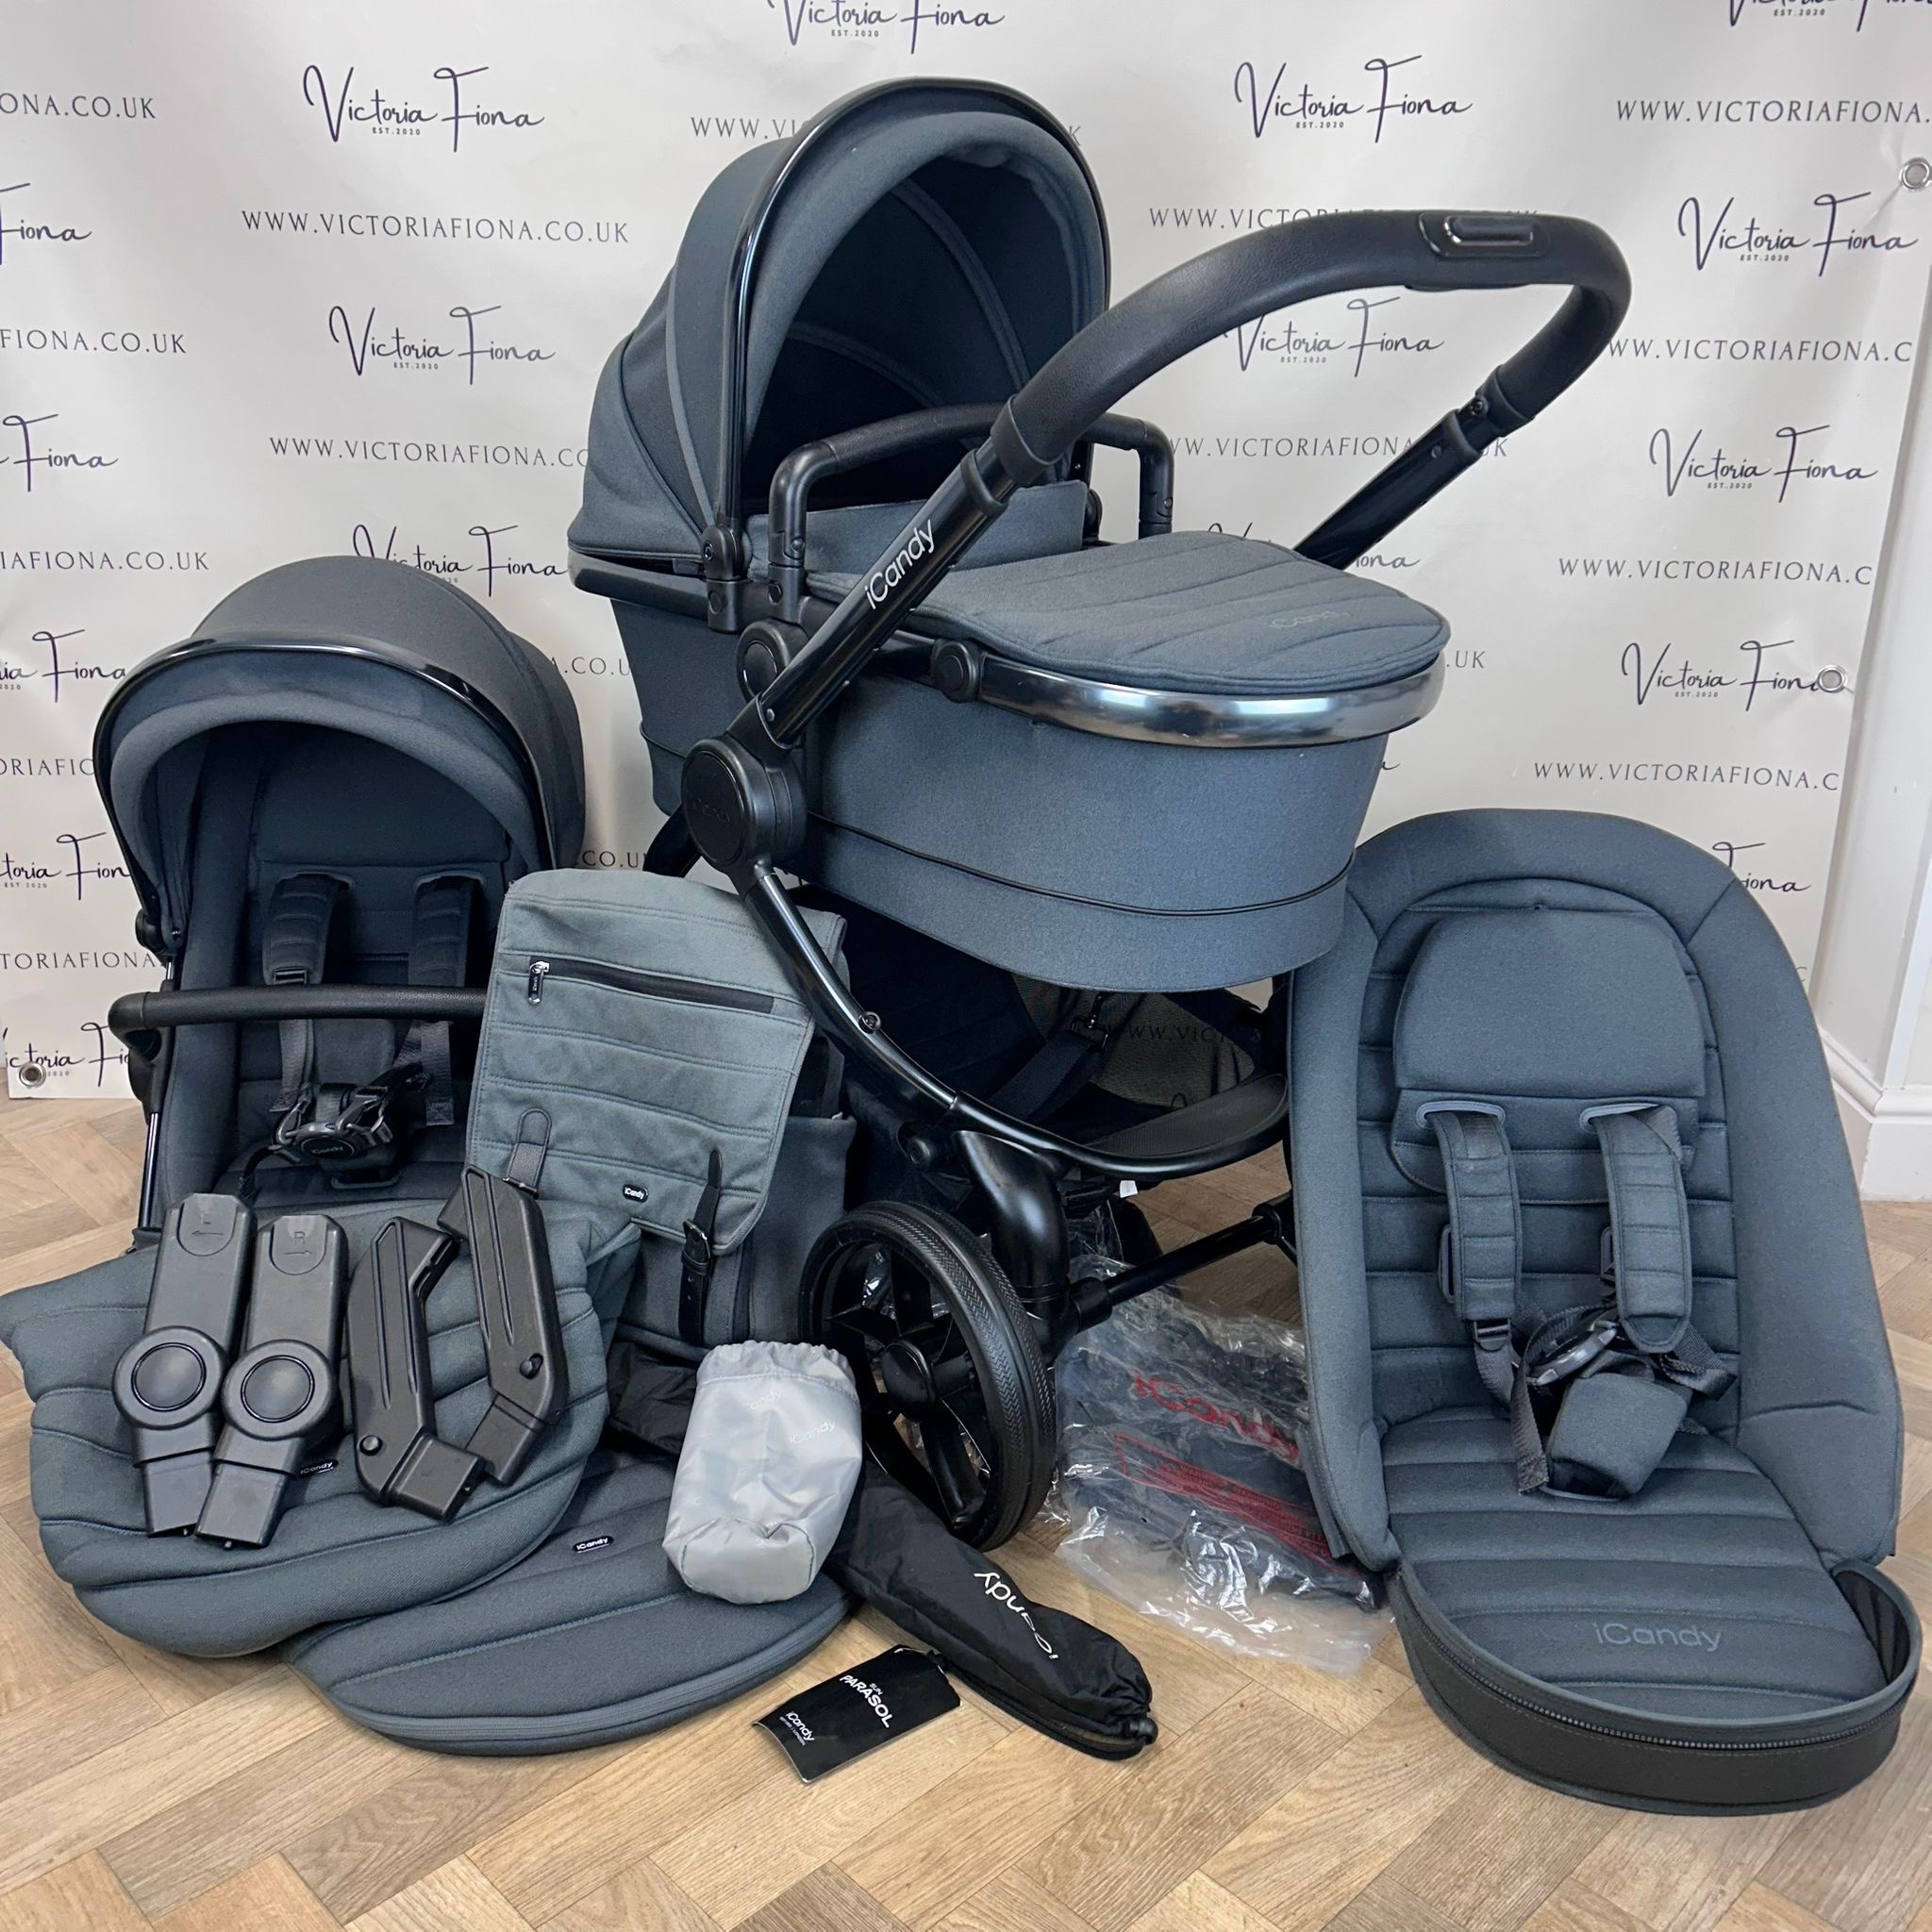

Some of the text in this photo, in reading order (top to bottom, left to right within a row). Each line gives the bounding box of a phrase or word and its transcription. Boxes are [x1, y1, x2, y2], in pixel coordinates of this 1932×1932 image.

[831, 29, 880, 38] EST.2020
[303, 64, 545, 153] Victoria Fiona
[372, 126, 422, 136] EST.2020
[1234, 55, 1474, 143] Victoria Fiona
[241, 209, 630, 243] WWW.VICTORIAFIONA.CO.UK
[1677, 192, 1920, 277] Victoria Fiona
[328, 305, 558, 386] Victoria Fiona
[1346, 296, 1445, 377] Fiona
[3, 413, 120, 493] Fiona
[1649, 425, 1879, 504] Victoria Fiona
[468, 525, 569, 598] Fiona
[864, 519, 935, 610] iCandy
[32, 628, 126, 704] Fiona
[1622, 642, 1738, 706] Victoria
[575, 1537, 609, 1551] iCandy
[1591, 1622, 1723, 1653] iCandy
[785, 1710, 816, 1741] iCandy
[839, 1674, 894, 1728] PARASOL
